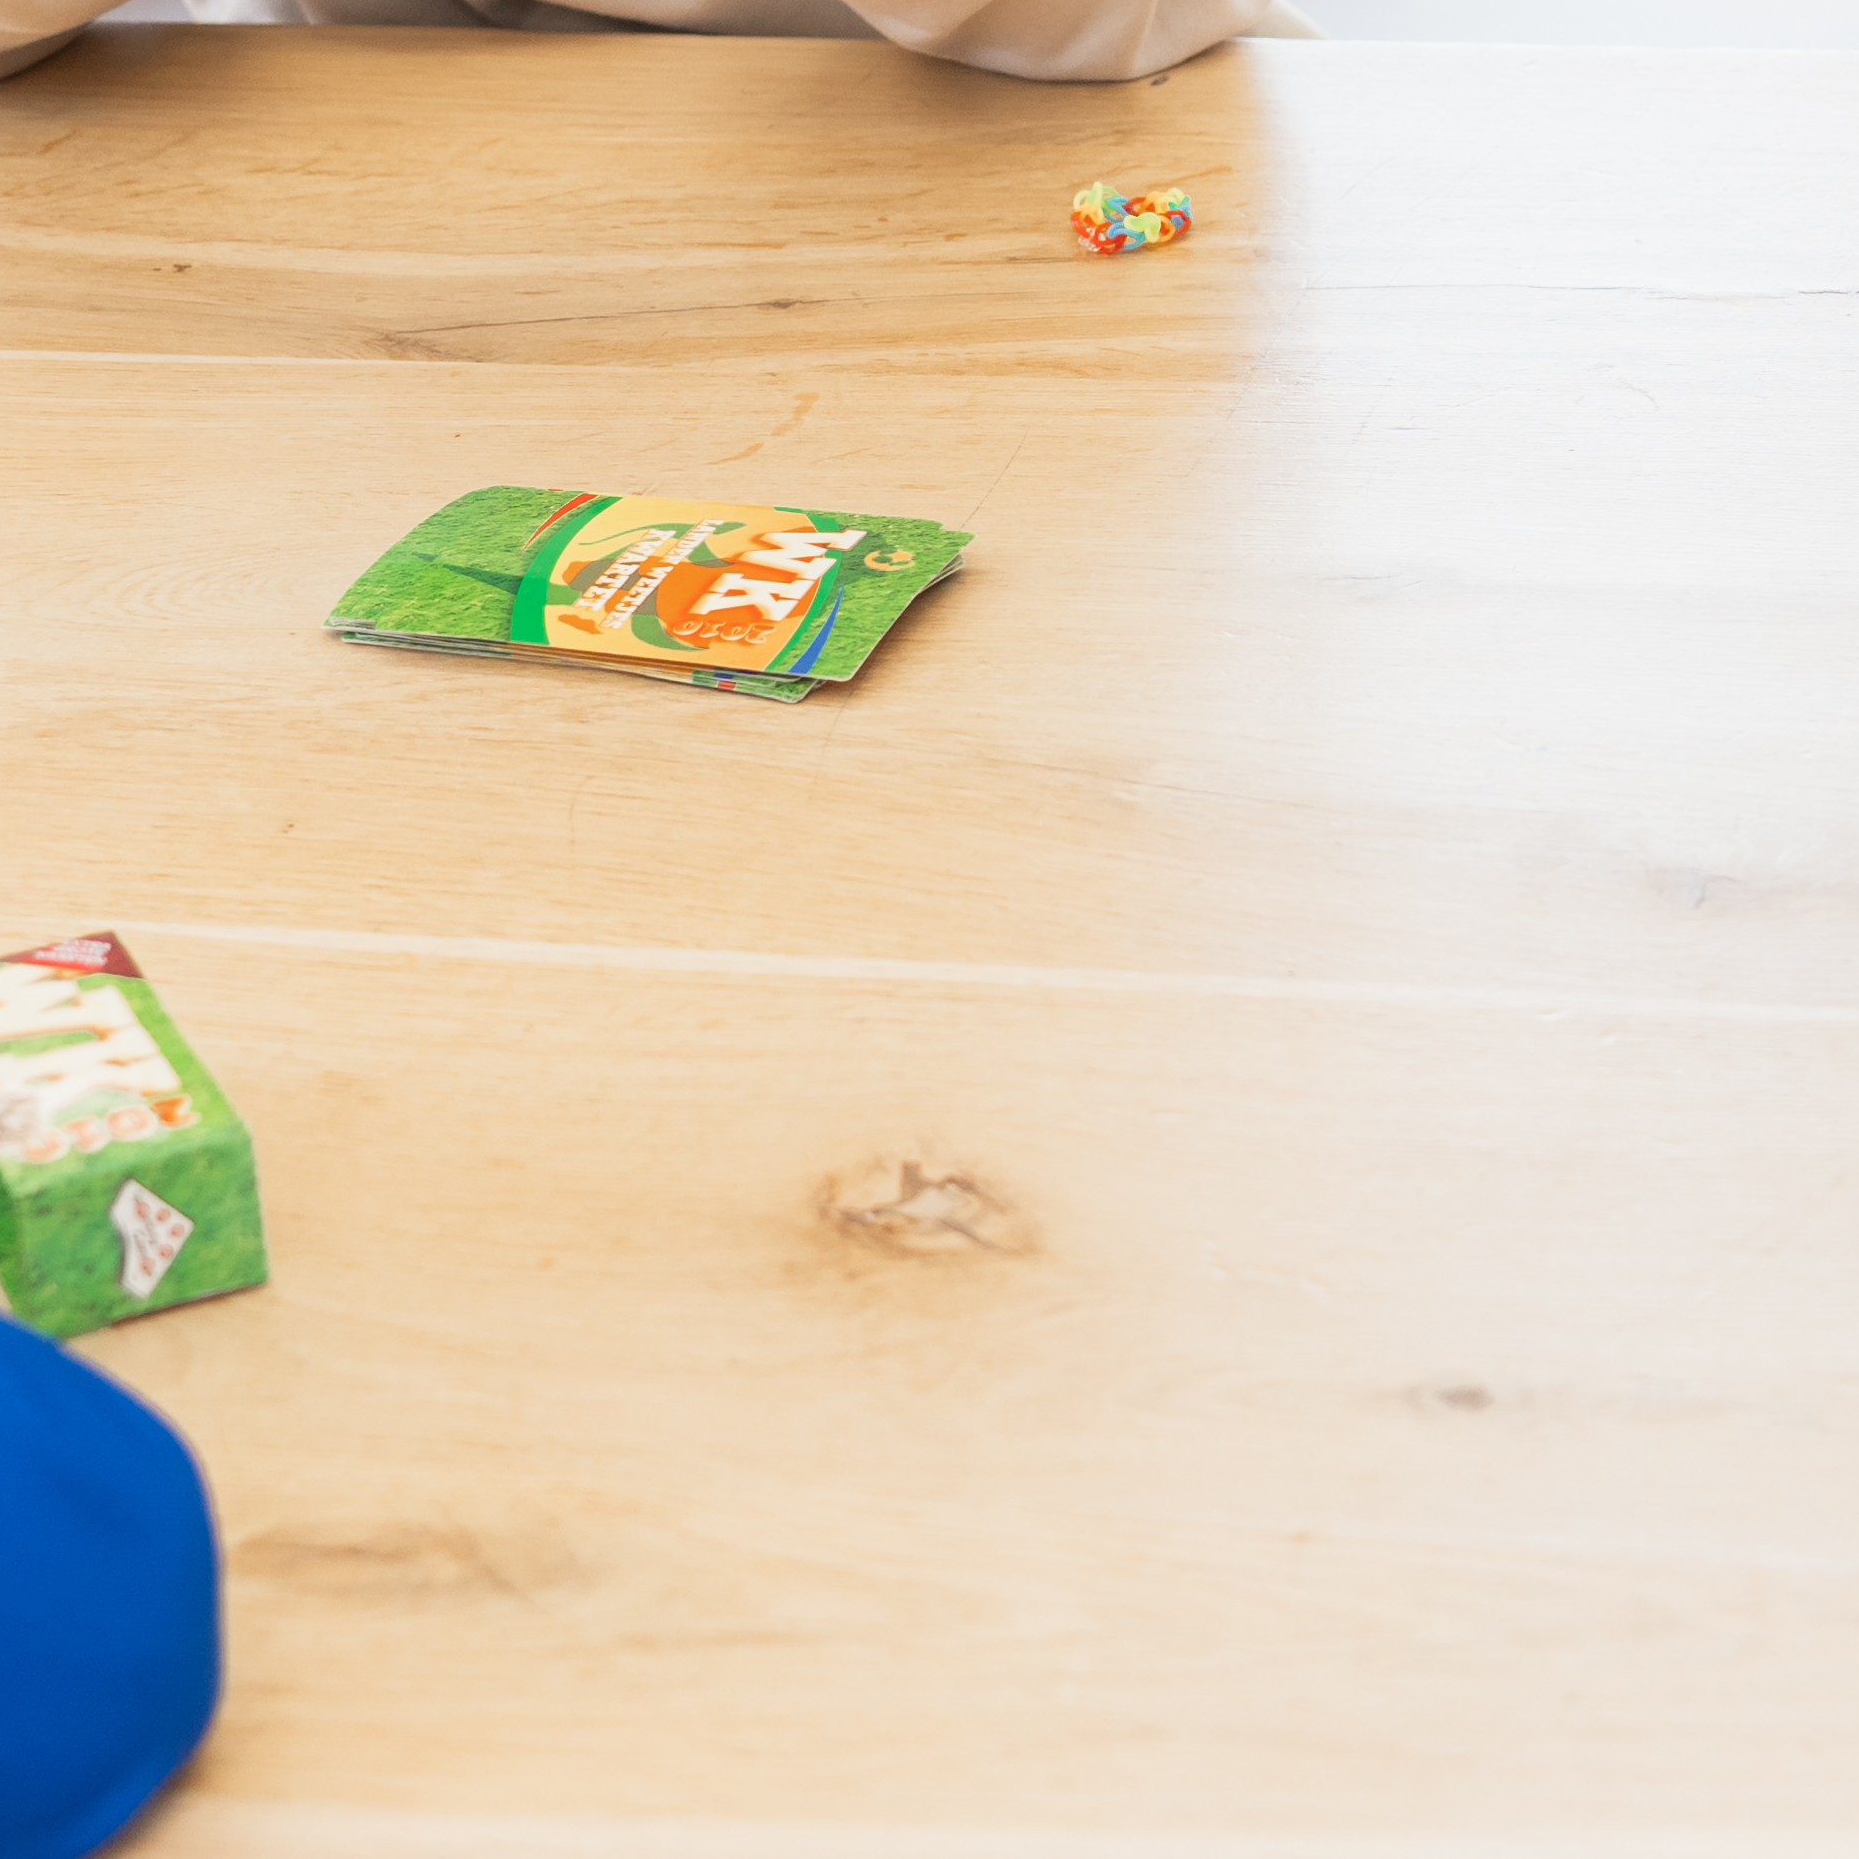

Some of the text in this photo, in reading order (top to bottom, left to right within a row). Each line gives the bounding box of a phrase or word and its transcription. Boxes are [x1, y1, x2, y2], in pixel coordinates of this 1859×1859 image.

[572, 528, 677, 613] KWARTET
[598, 518, 724, 630] LANDEN WEETJES
[689, 529, 868, 622] WK
[673, 619, 777, 645] 2010
